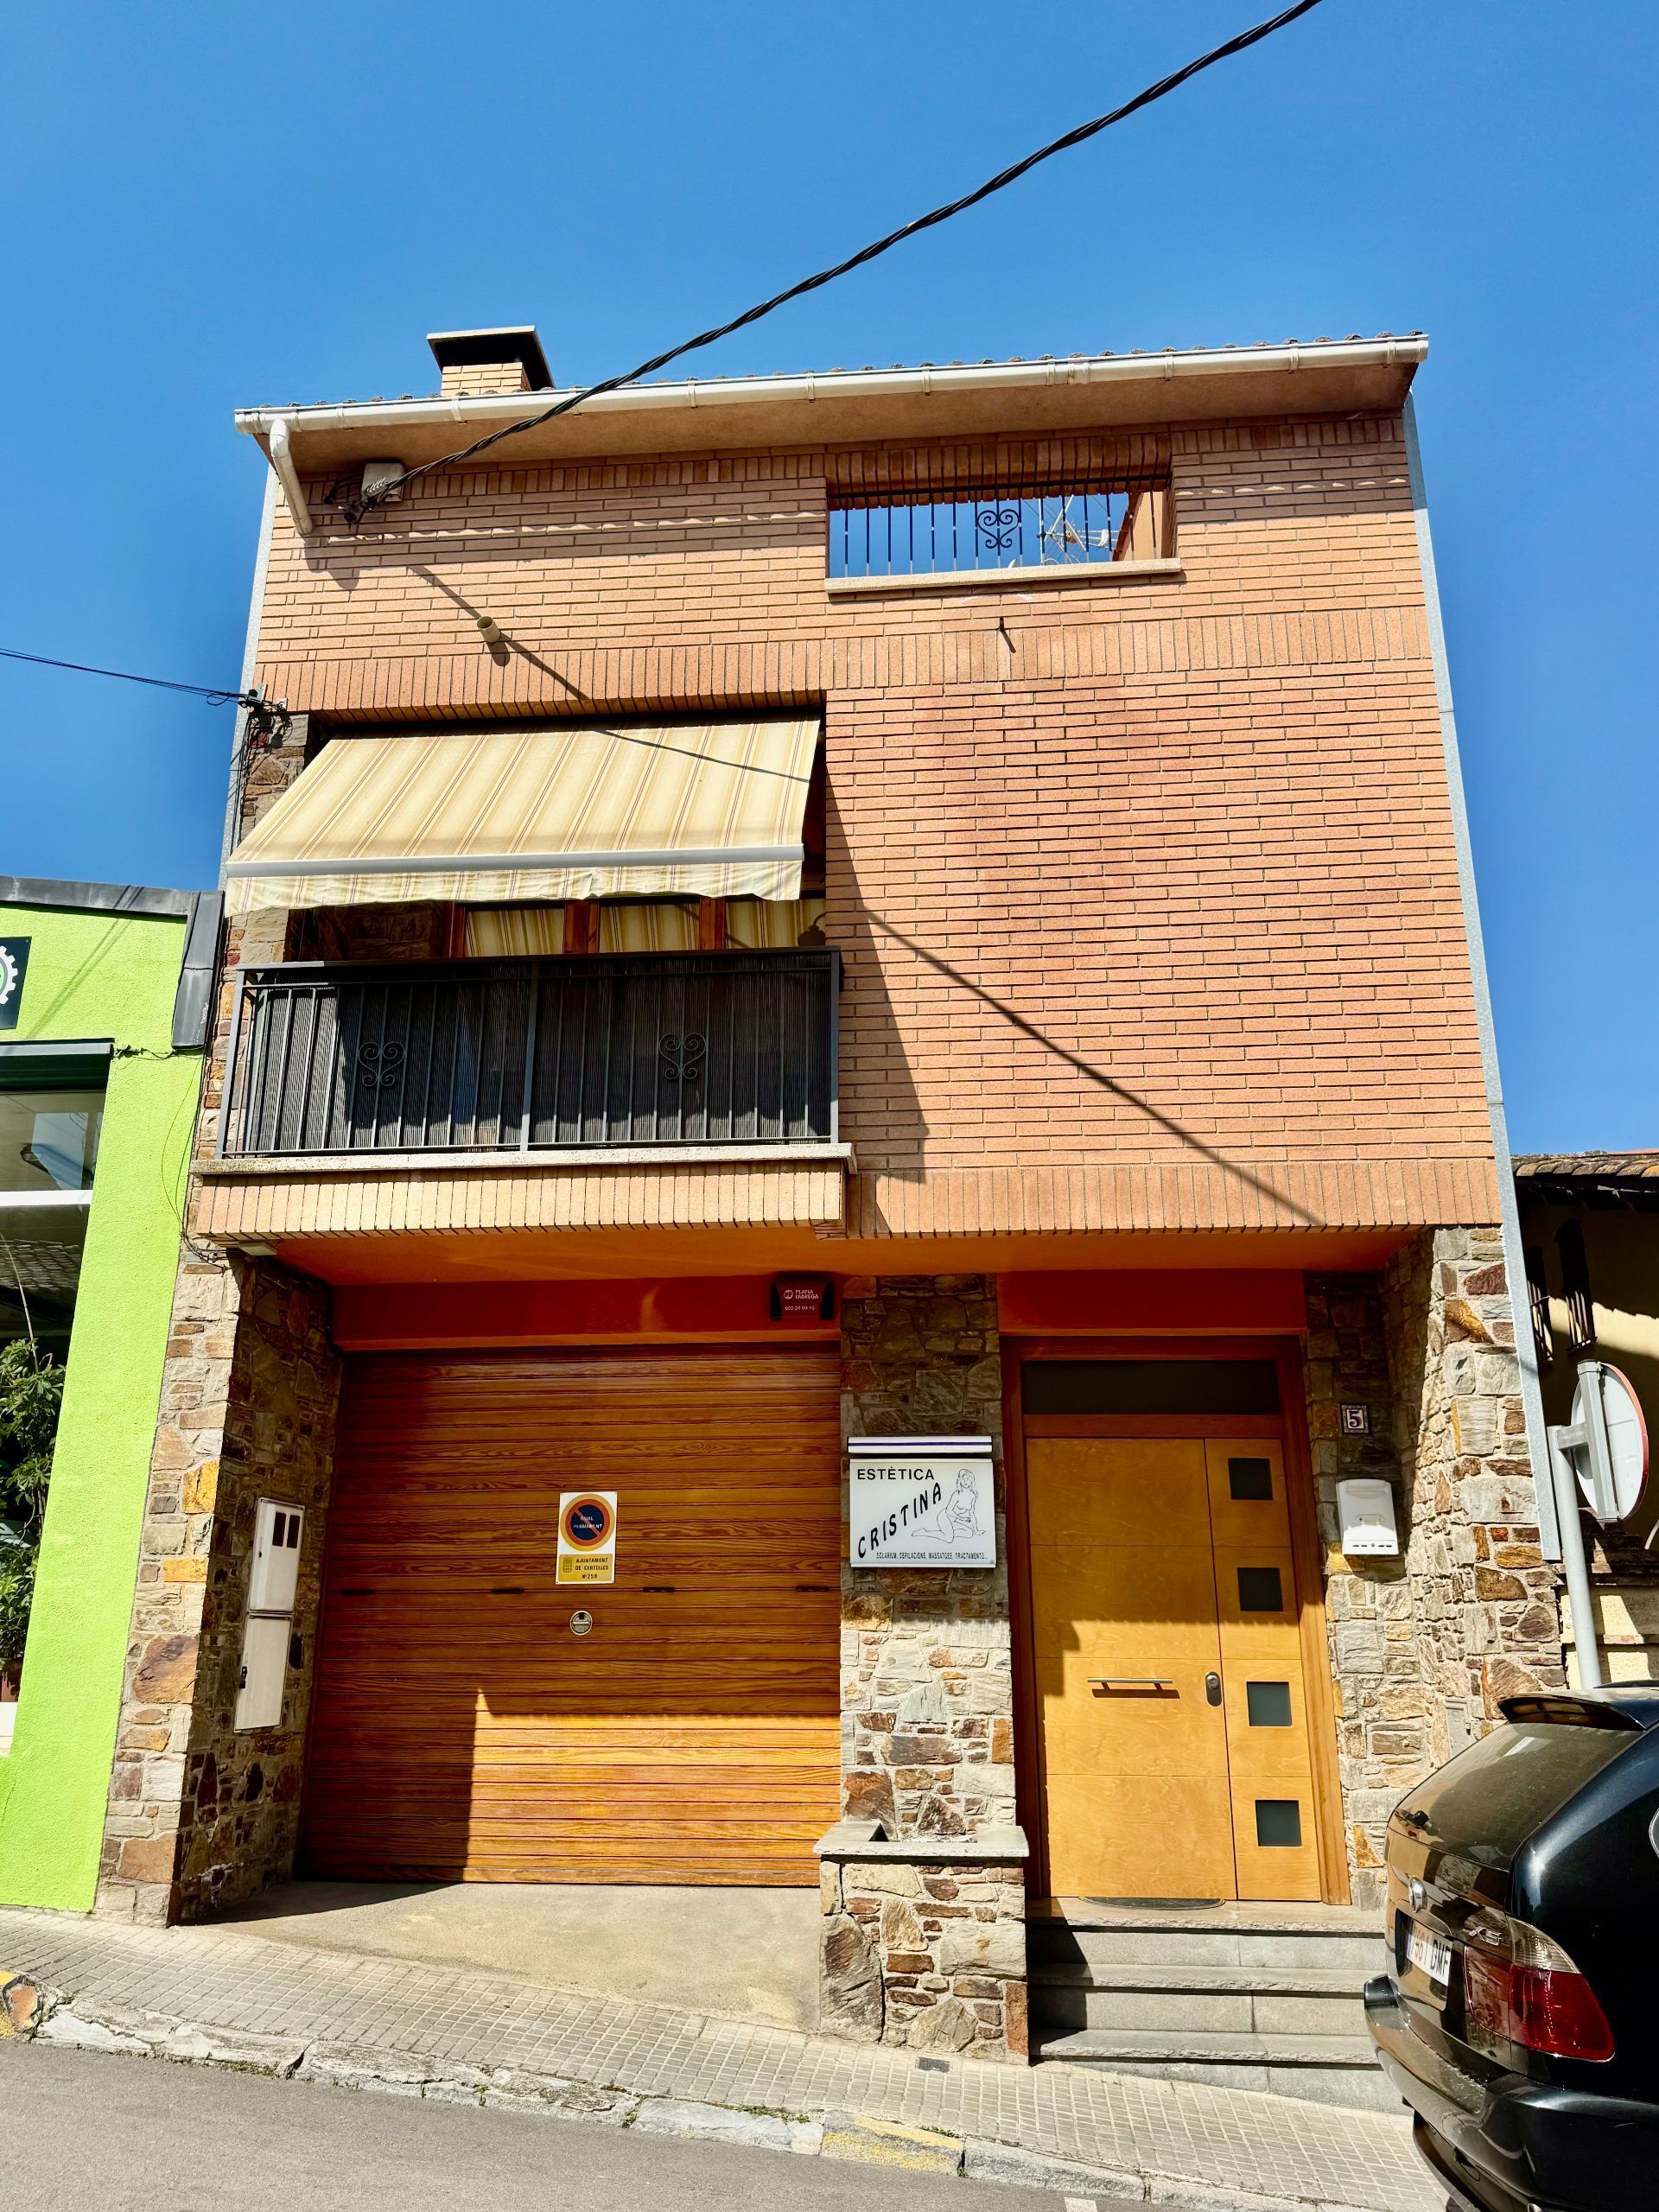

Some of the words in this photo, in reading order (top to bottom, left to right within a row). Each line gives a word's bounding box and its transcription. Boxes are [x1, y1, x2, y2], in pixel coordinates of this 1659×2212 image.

[1349, 1410, 1362, 1427] 5
[857, 1466, 934, 1480] ESTÈTICA
[858, 1482, 941, 1559] CRISTINA
[1462, 1922, 1502, 1946] X5
